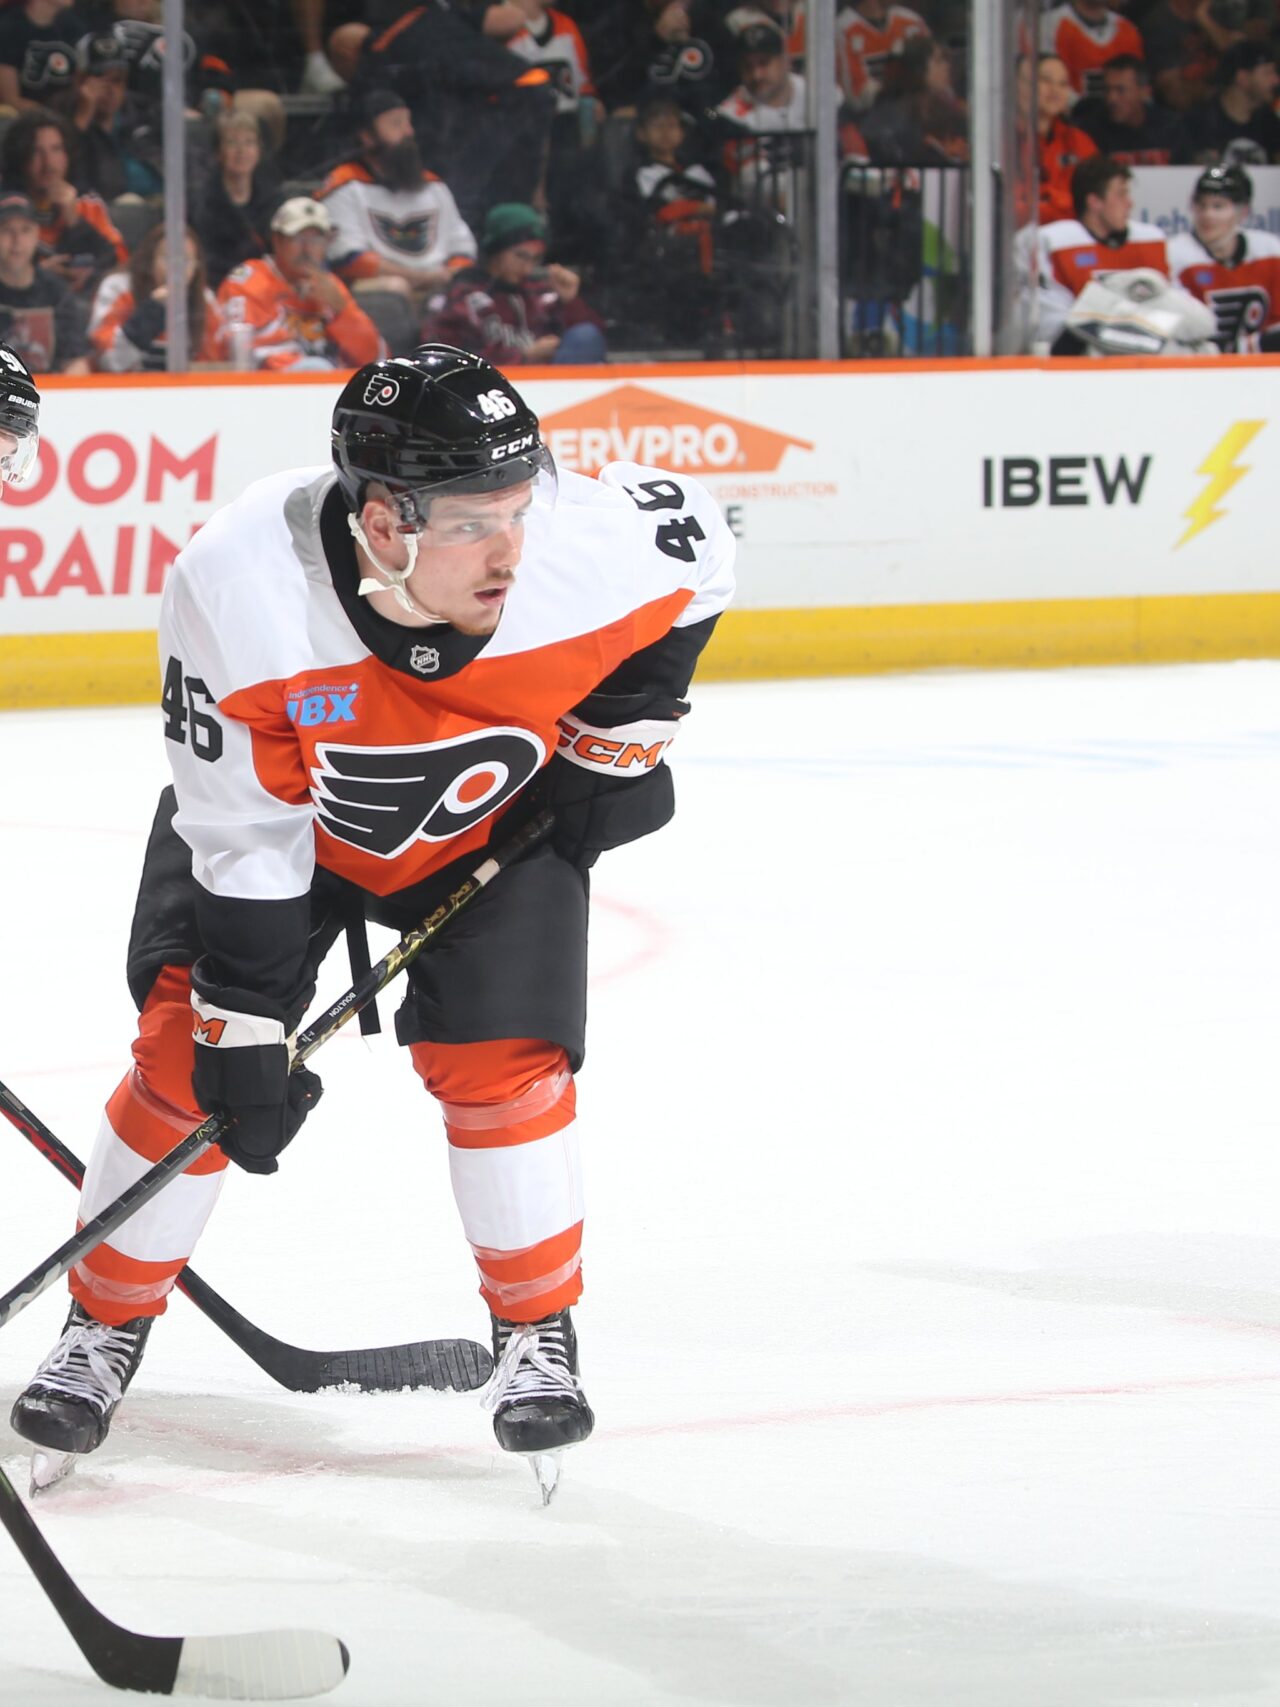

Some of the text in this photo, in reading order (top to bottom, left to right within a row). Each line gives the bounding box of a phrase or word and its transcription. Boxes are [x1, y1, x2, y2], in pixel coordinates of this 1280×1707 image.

[477, 389, 517, 421] 46
[490, 433, 533, 460] CCM
[983, 455, 1151, 507] IBEW
[161, 655, 224, 763] 46
[329, 991, 357, 1019] BOULTON
